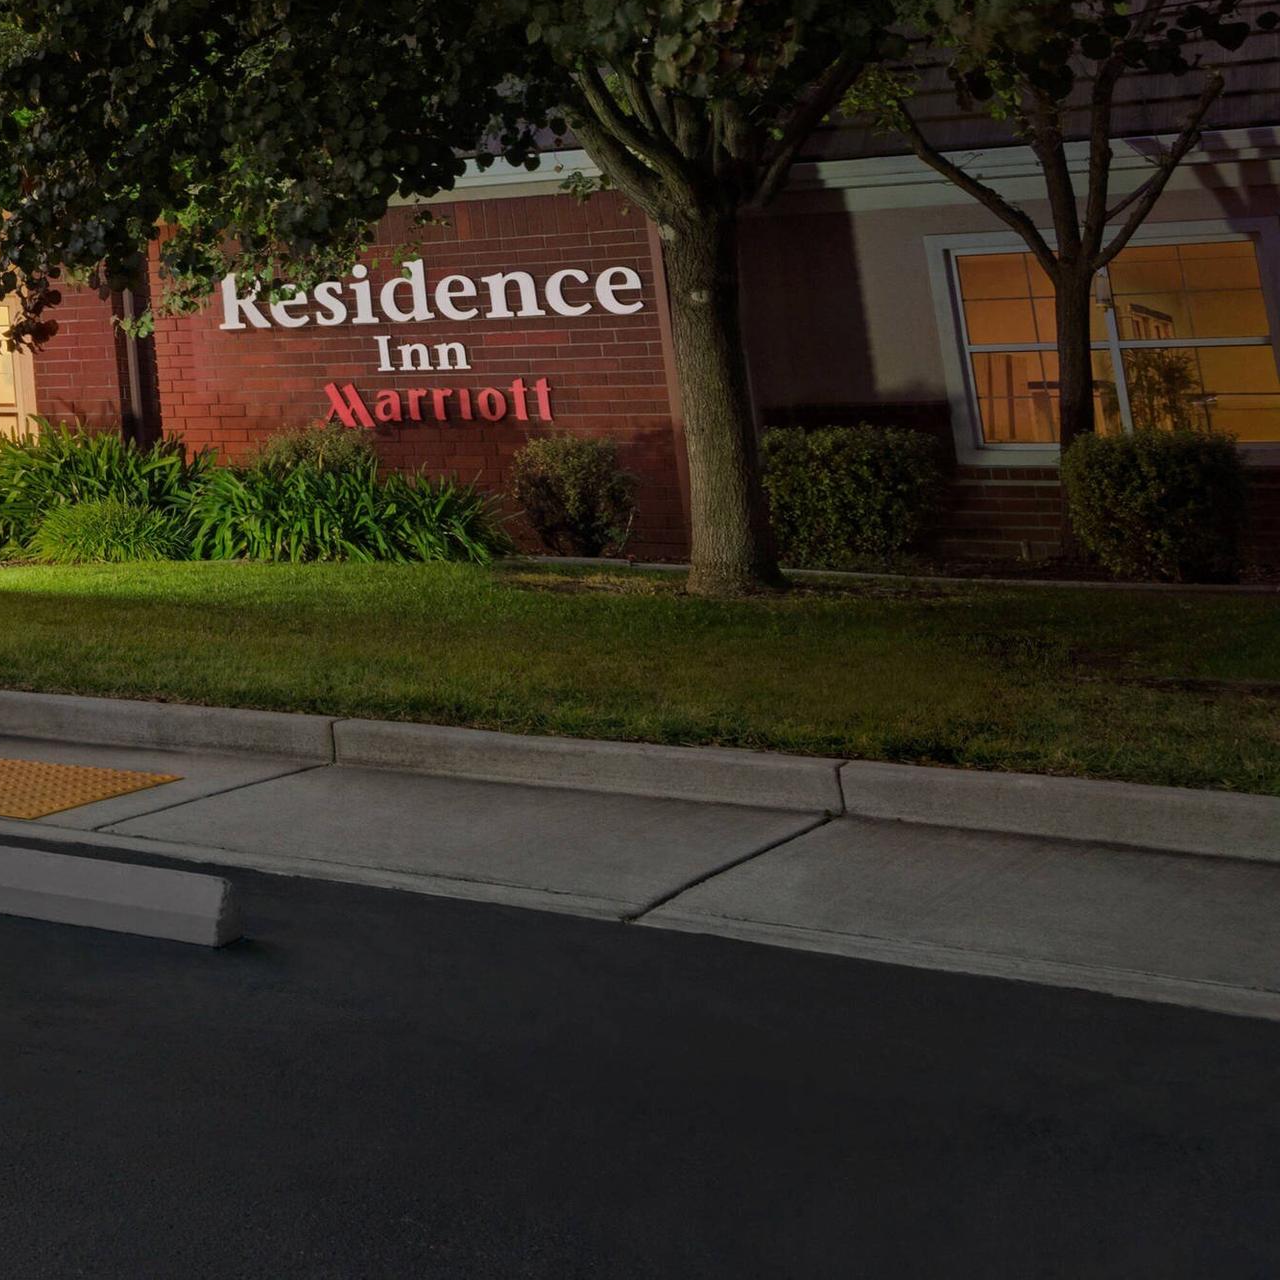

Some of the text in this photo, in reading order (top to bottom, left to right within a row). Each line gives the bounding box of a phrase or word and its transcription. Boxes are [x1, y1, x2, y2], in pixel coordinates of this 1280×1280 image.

[219, 258, 644, 330] Residence
[373, 335, 471, 372] Inn
[319, 377, 553, 428] Marriott
